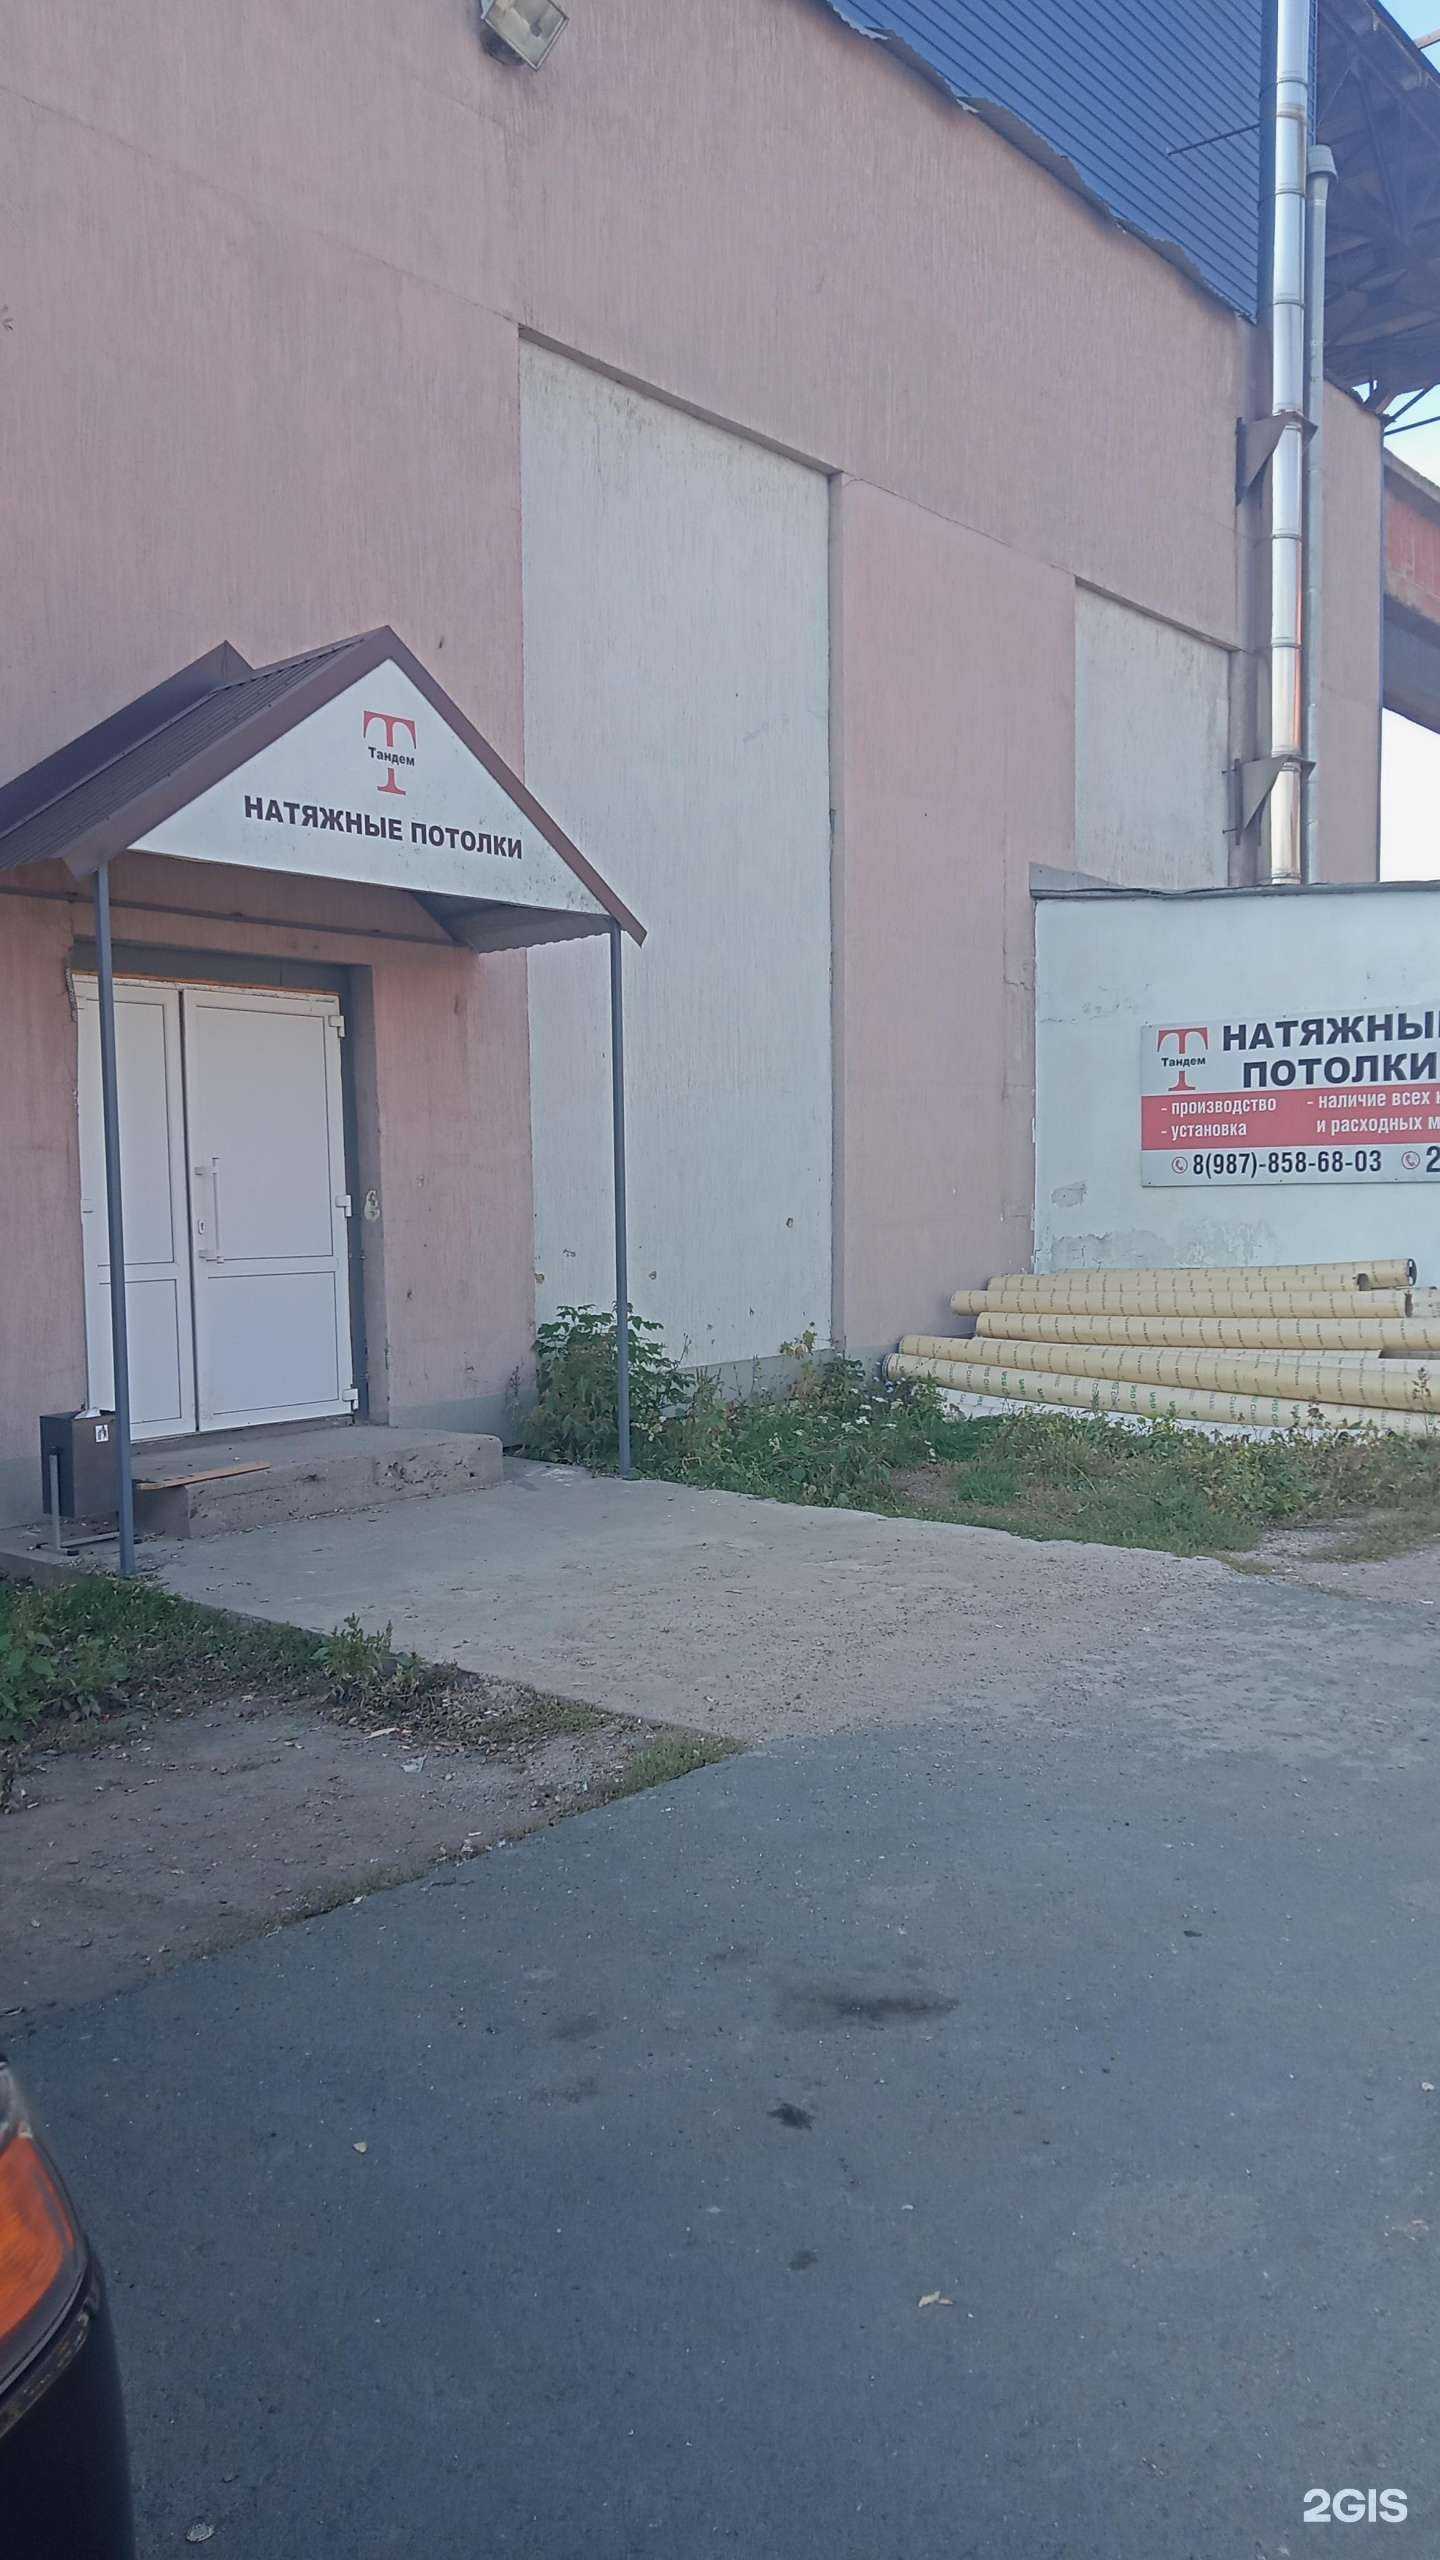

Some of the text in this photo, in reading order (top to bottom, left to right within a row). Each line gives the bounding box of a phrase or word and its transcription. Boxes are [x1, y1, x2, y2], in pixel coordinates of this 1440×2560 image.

[367, 746, 415, 767] Тандем
[244, 795, 523, 859] НАТЯЖНЫЕ ПОТОЛКИ
[1222, 1010, 1440, 1051] НАТЯЖНЫ
[1161, 1057, 1206, 1067] Тандем
[1243, 1051, 1437, 1088] ПОТОЛКИ
[1171, 1097, 1277, 1116] производство
[1318, 1093, 1387, 1109] наличие
[1392, 1091, 1430, 1106] всех
[1171, 1121, 1247, 1141] установка
[1316, 1119, 1326, 1133] и
[1331, 1116, 1423, 1136] расходных
[1192, 1150, 1382, 1179] 8(987)-858-68-03
